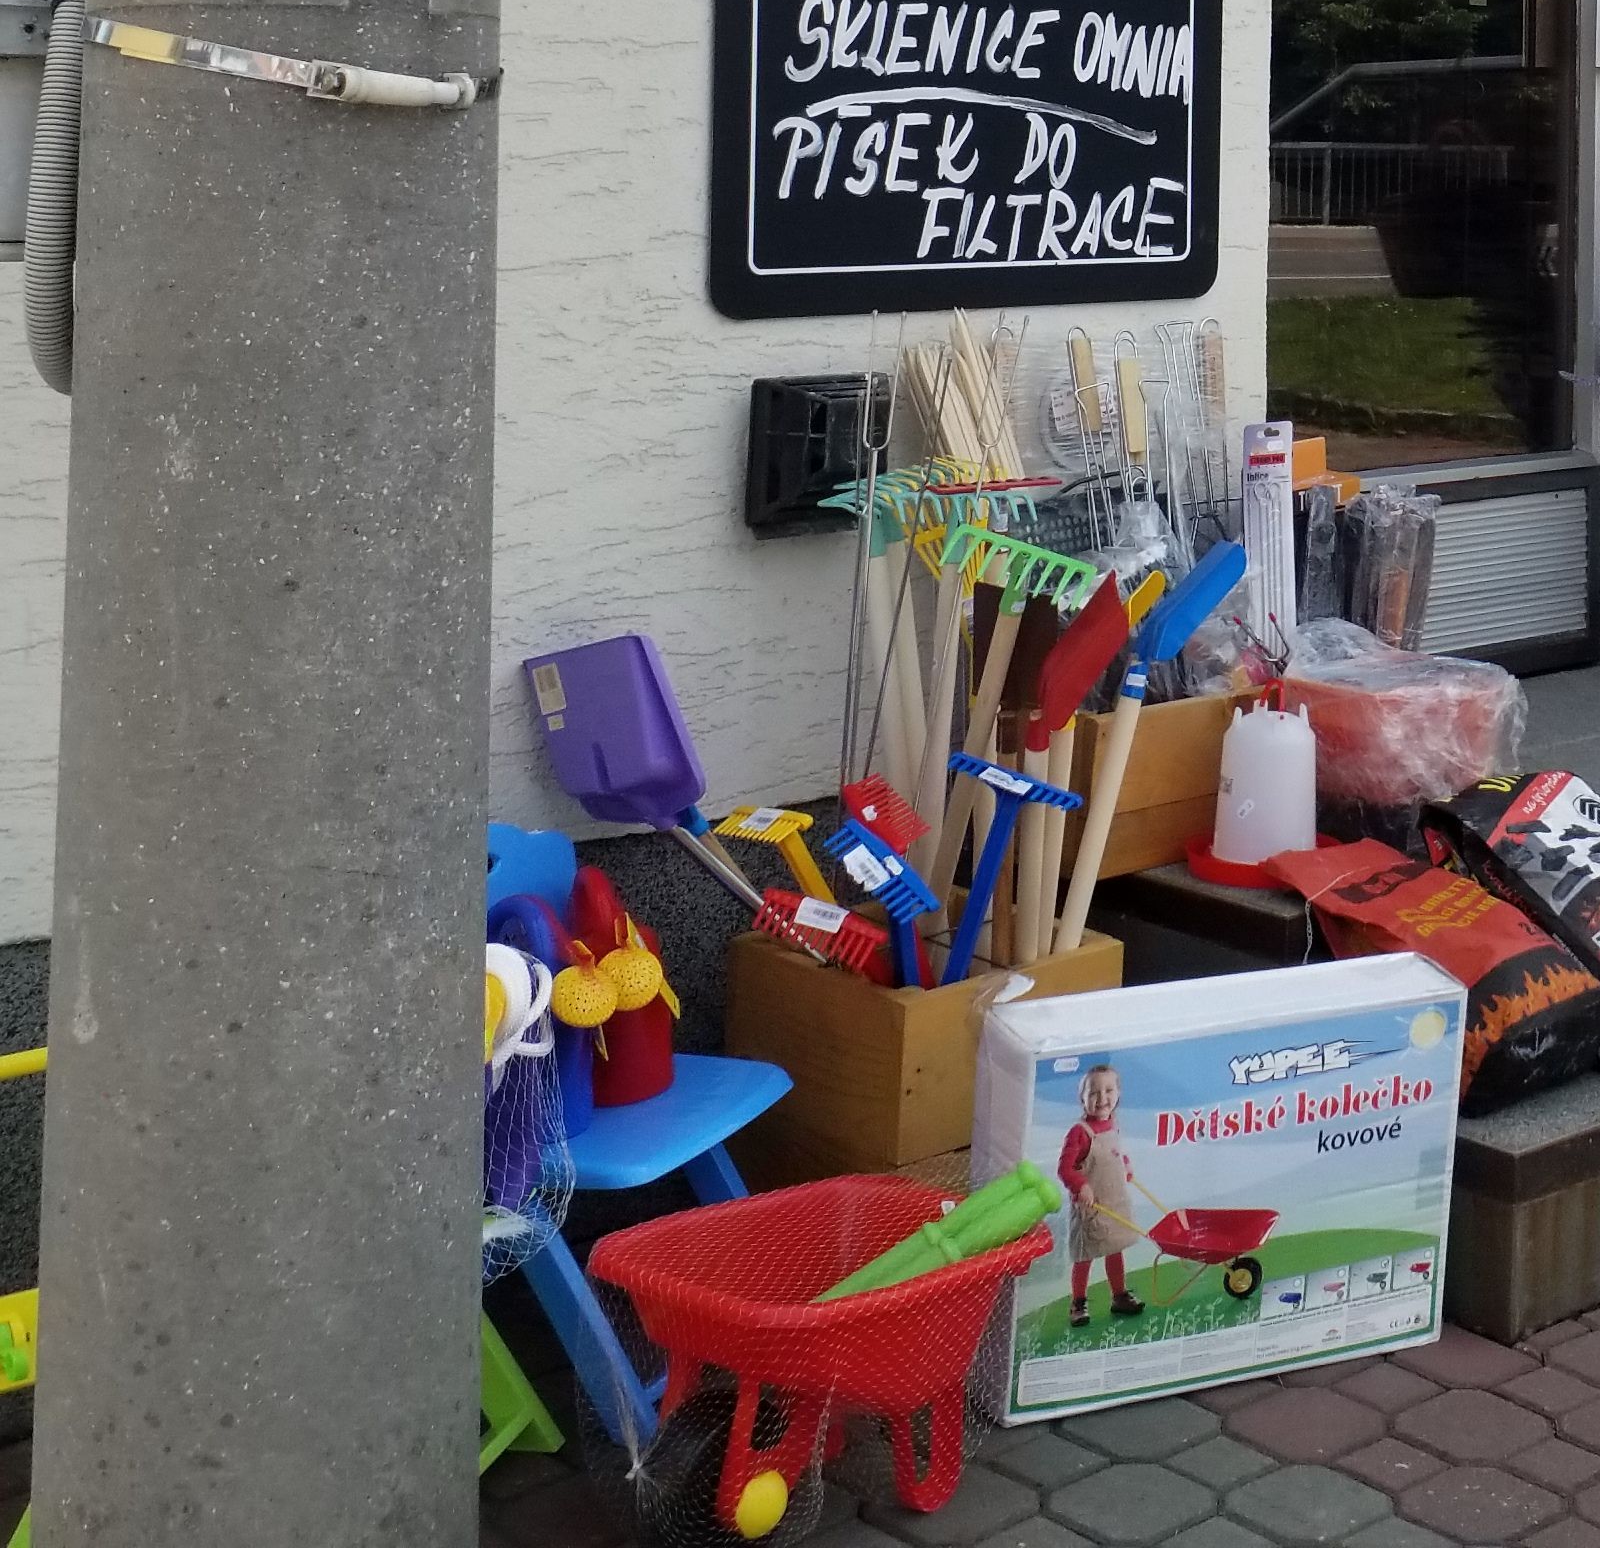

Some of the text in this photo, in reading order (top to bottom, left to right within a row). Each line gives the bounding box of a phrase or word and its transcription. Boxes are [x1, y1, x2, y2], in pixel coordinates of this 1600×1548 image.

[1073, 10, 1191, 105] OMNIA
[773, 106, 1076, 199] PÍSEK DO
[917, 178, 1186, 260] FILTRACE
[1228, 1039, 1351, 1085] YUPEE
[1156, 1075, 1433, 1148] Dětské kolečko
[1317, 1115, 1402, 1154] kovové
